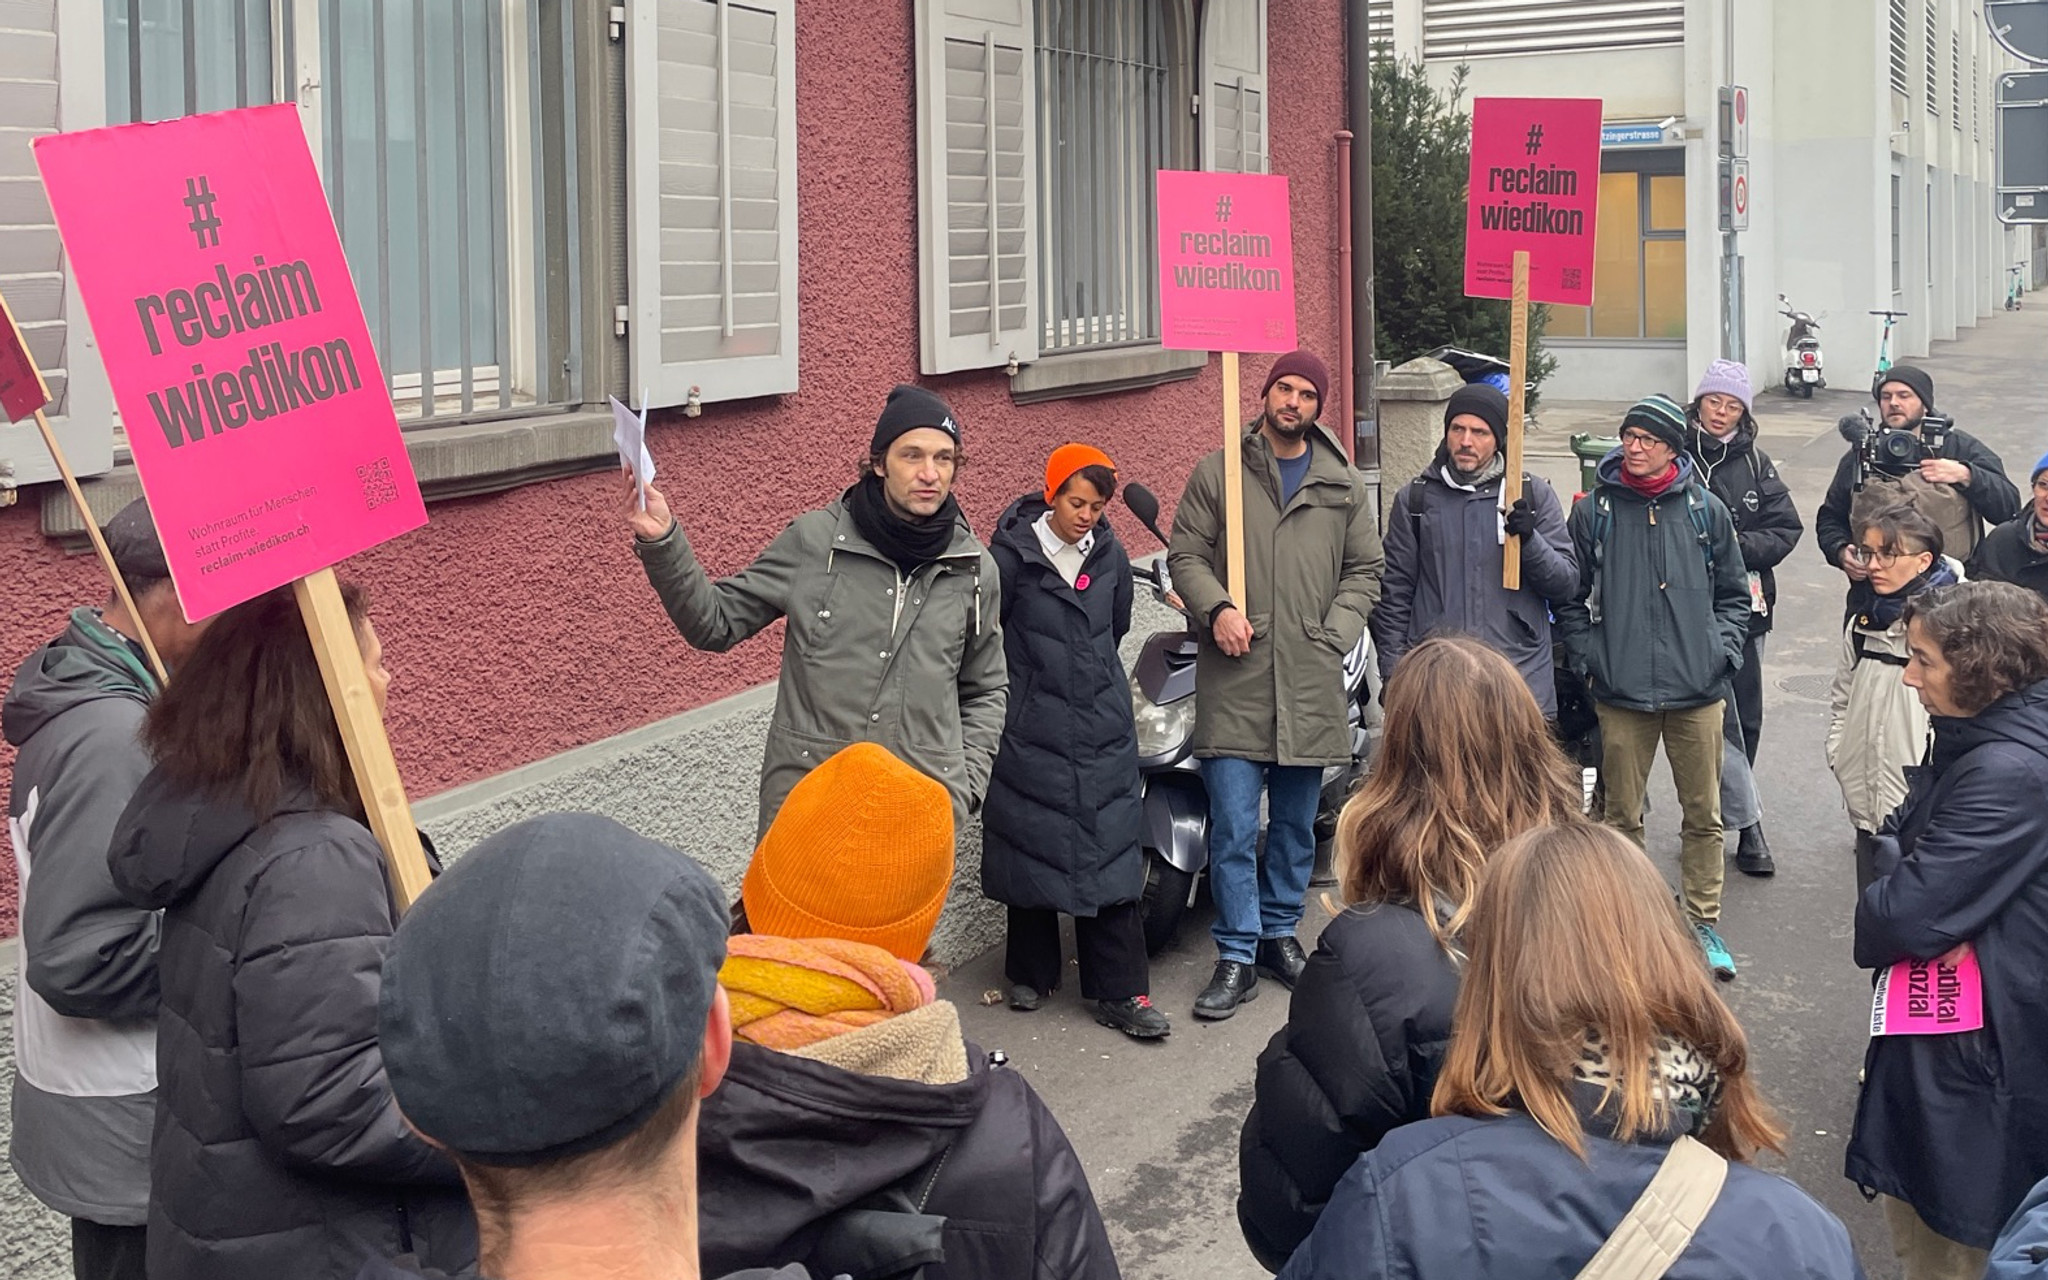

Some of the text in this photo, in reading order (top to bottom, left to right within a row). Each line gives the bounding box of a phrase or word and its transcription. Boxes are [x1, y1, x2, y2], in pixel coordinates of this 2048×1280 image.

[1526, 124, 1544, 155] #
[1602, 130, 1660, 142] tzingerstrasse
[1489, 163, 1577, 196] reclaim
[183, 176, 222, 249] #
[1216, 195, 1232, 222] #
[1481, 200, 1583, 235] wiedikon
[1180, 228, 1271, 257] reclaim
[1173, 262, 1281, 291] wiedikon
[135, 255, 322, 356] reclaim
[146, 338, 362, 449] wiedikon
[188, 485, 318, 541] Wohnraum für Menschen
[194, 540, 221, 558] statt
[200, 524, 310, 576] reclaim-wiedikon.ch
[1908, 959, 1934, 1017] sozial
[1937, 961, 1961, 1024] adikal
[1872, 1007, 1885, 1033] Liste
